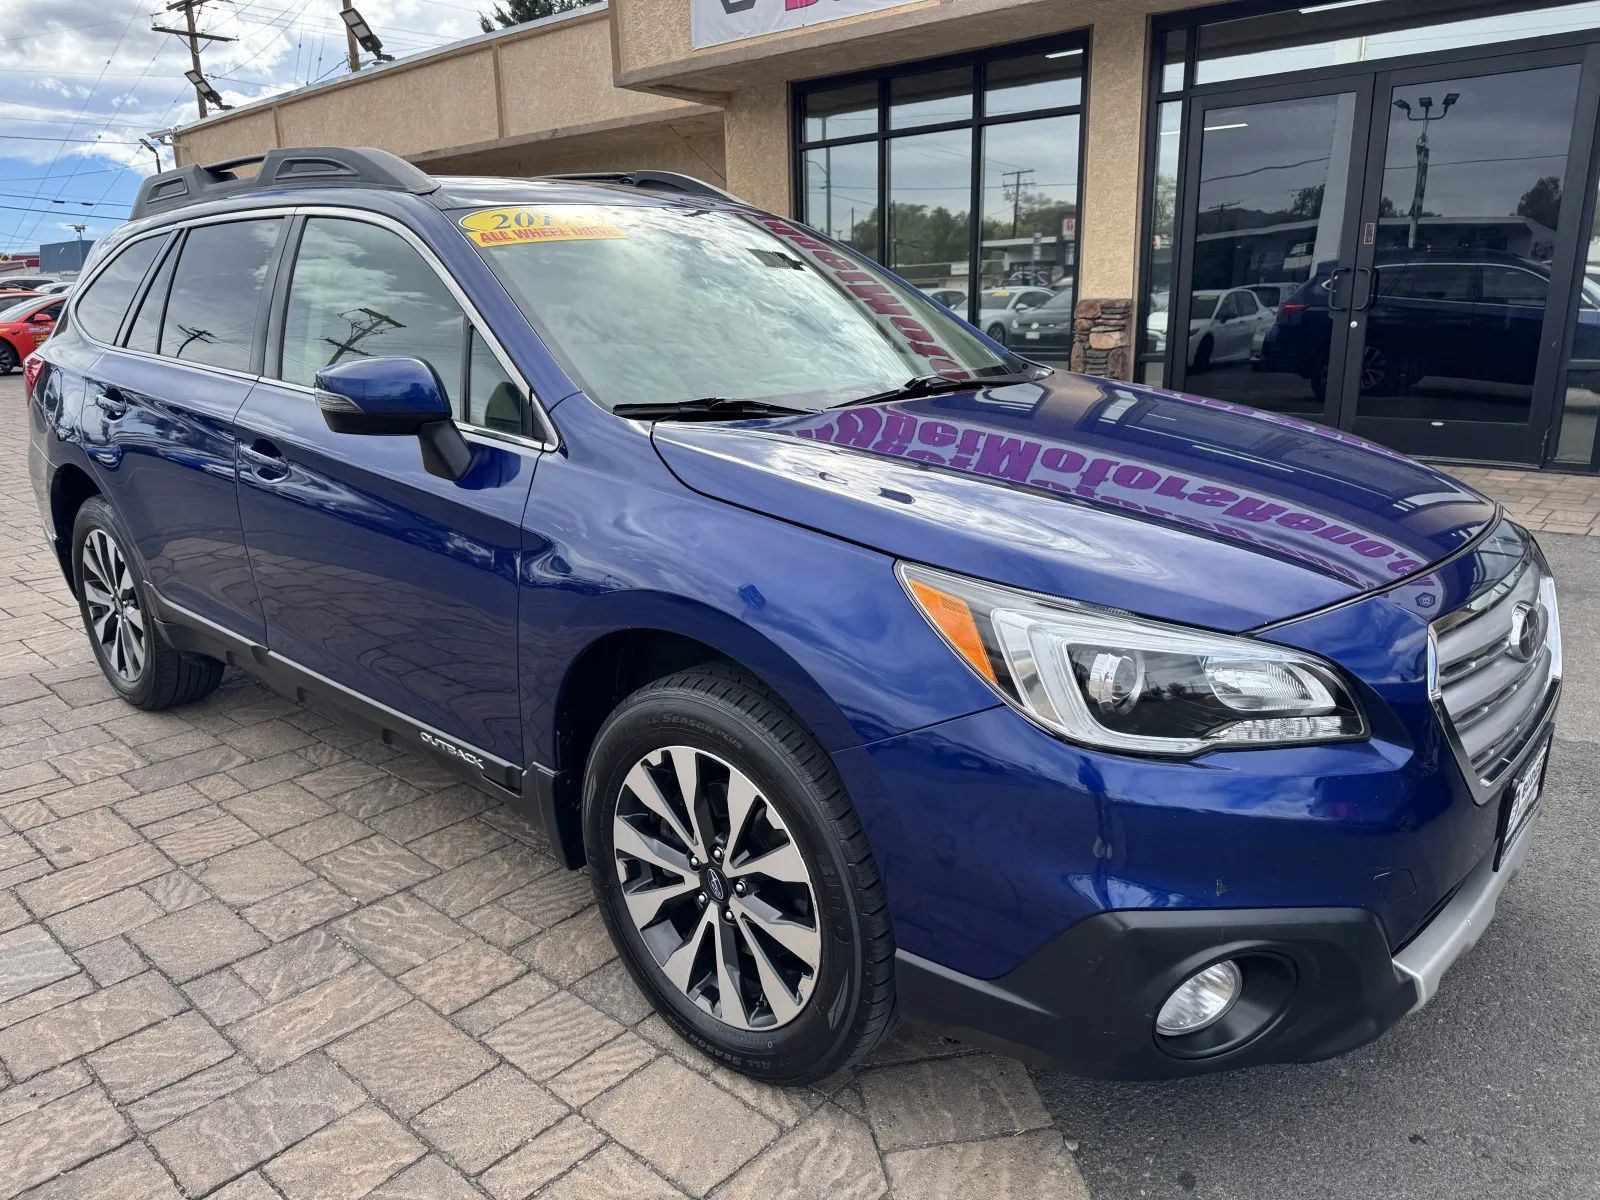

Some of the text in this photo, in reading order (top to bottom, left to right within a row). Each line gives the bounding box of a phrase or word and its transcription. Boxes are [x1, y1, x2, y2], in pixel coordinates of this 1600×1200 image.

[479, 229, 513, 245] ALL
[512, 226, 570, 241] WHEEL
[661, 712, 715, 734] SEASON
[419, 730, 485, 771] OUTBACK
